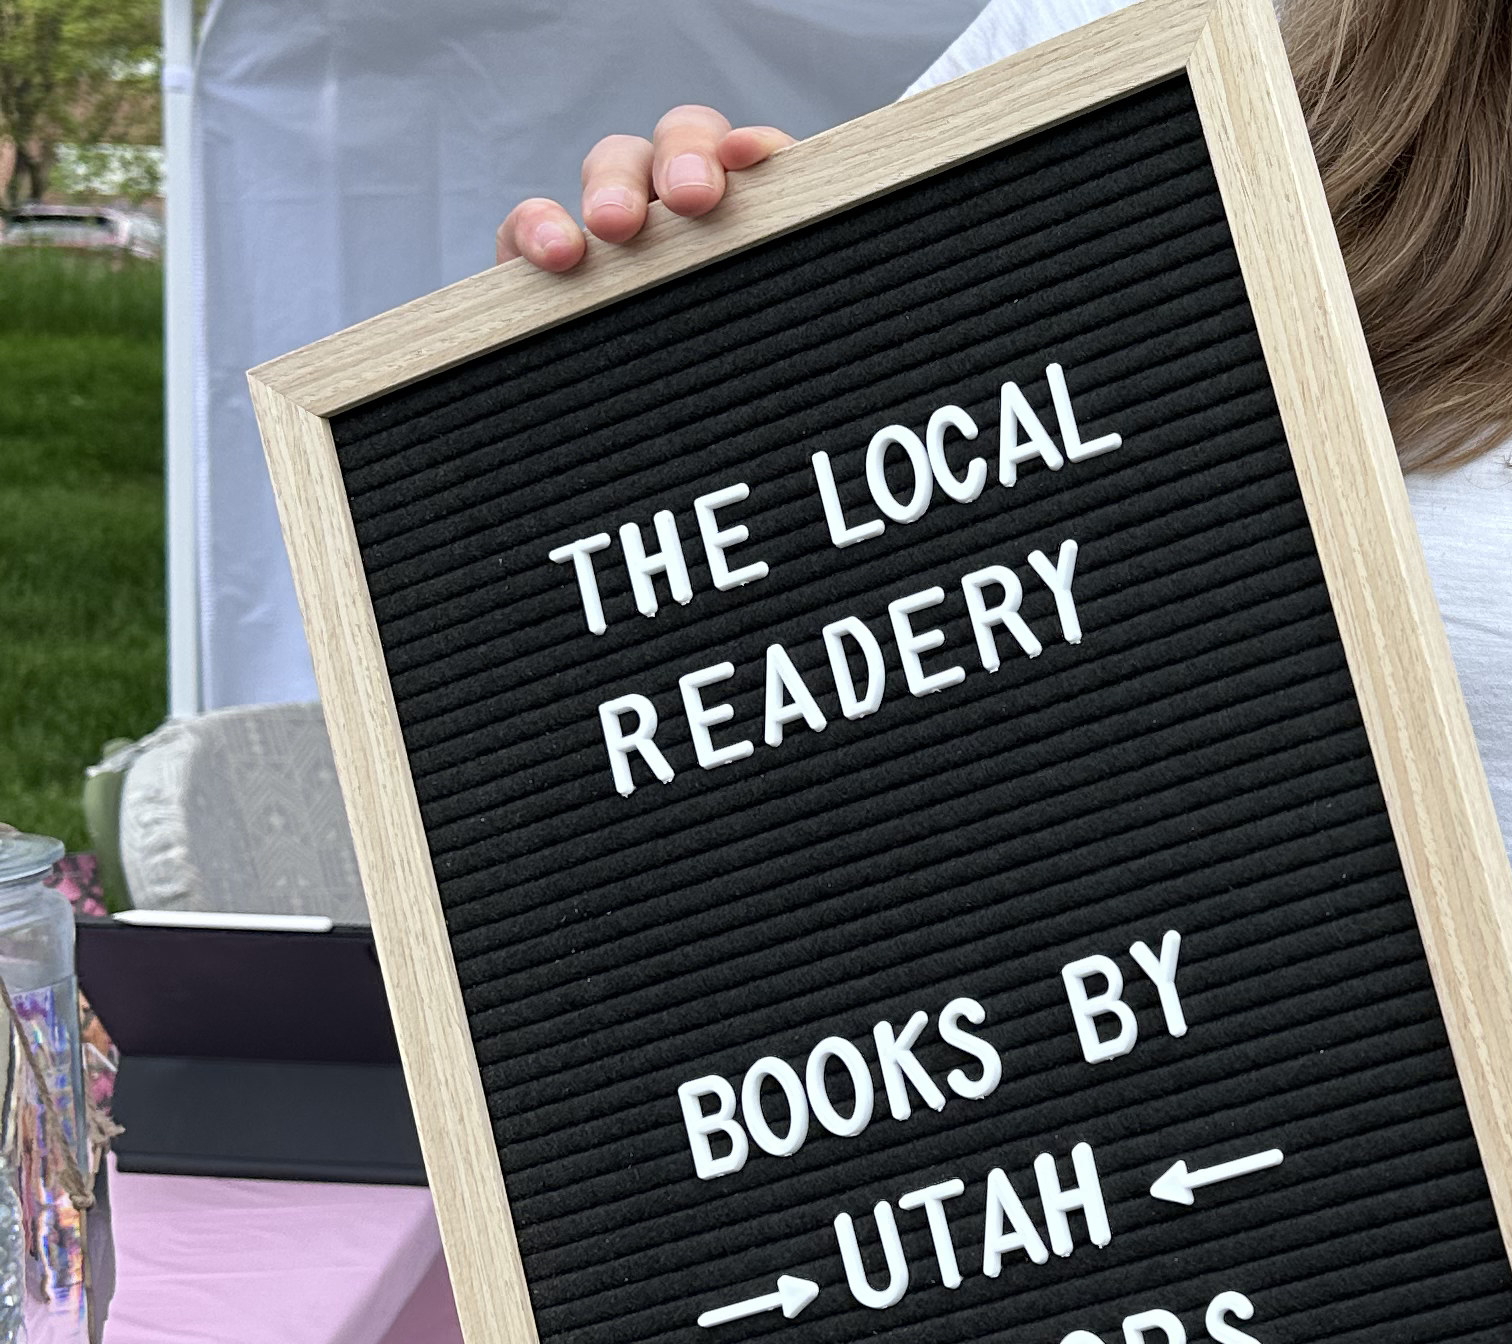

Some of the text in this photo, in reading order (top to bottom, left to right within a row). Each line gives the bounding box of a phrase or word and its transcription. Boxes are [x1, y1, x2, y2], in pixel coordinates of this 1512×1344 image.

[548, 362, 1123, 636] THE LOCAL
[598, 538, 1083, 797] READERY
[676, 929, 1188, 1180] BOOKS BY
[834, 1141, 1112, 1309] UTAH
